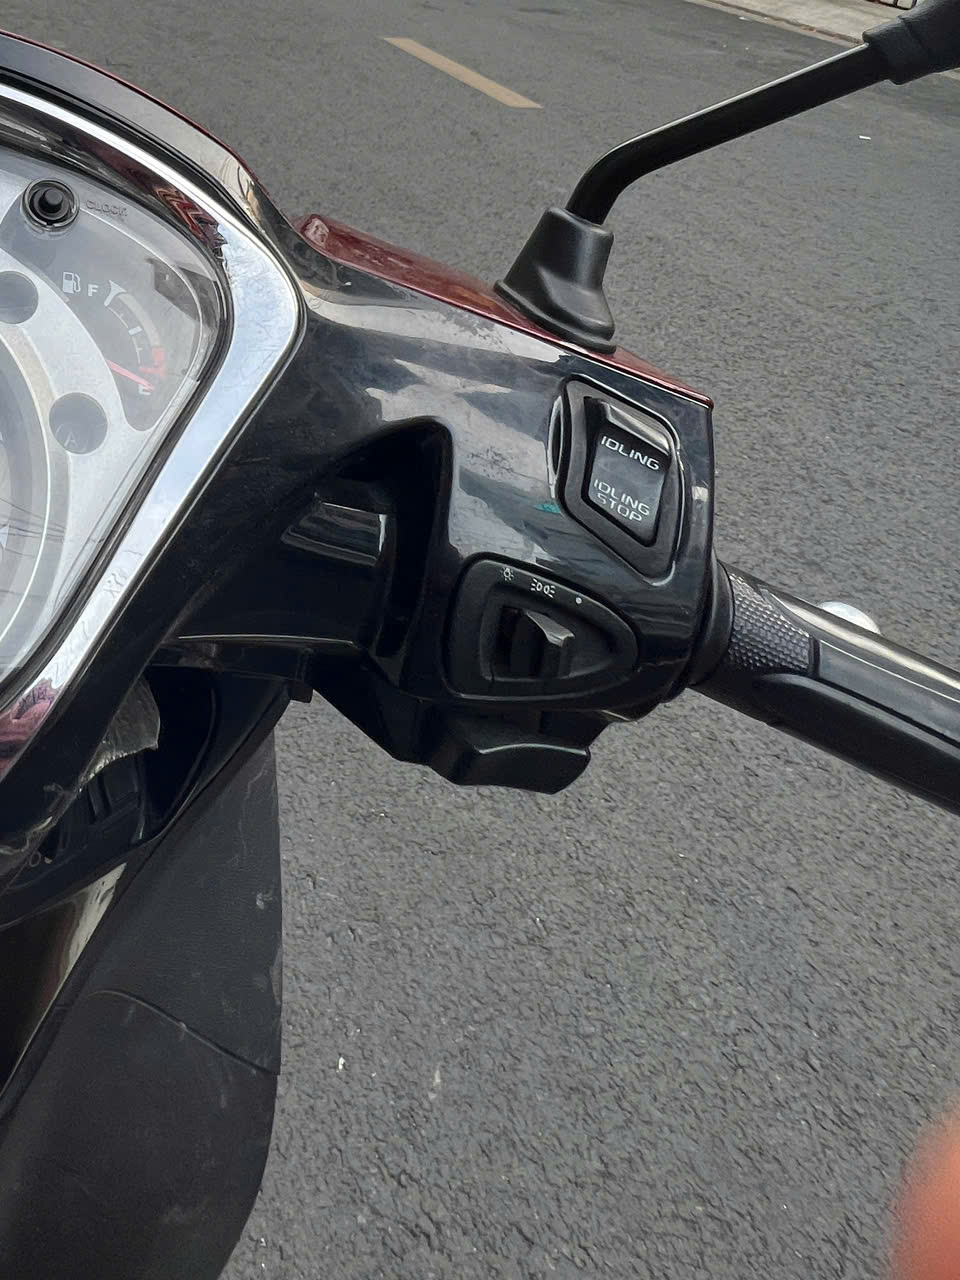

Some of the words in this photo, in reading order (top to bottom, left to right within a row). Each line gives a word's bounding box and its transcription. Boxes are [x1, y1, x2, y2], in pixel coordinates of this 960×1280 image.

[87, 283, 99, 297] F
[601, 435, 660, 470] IDLING
[594, 478, 650, 516] IDLING
[596, 492, 643, 522] STOP
